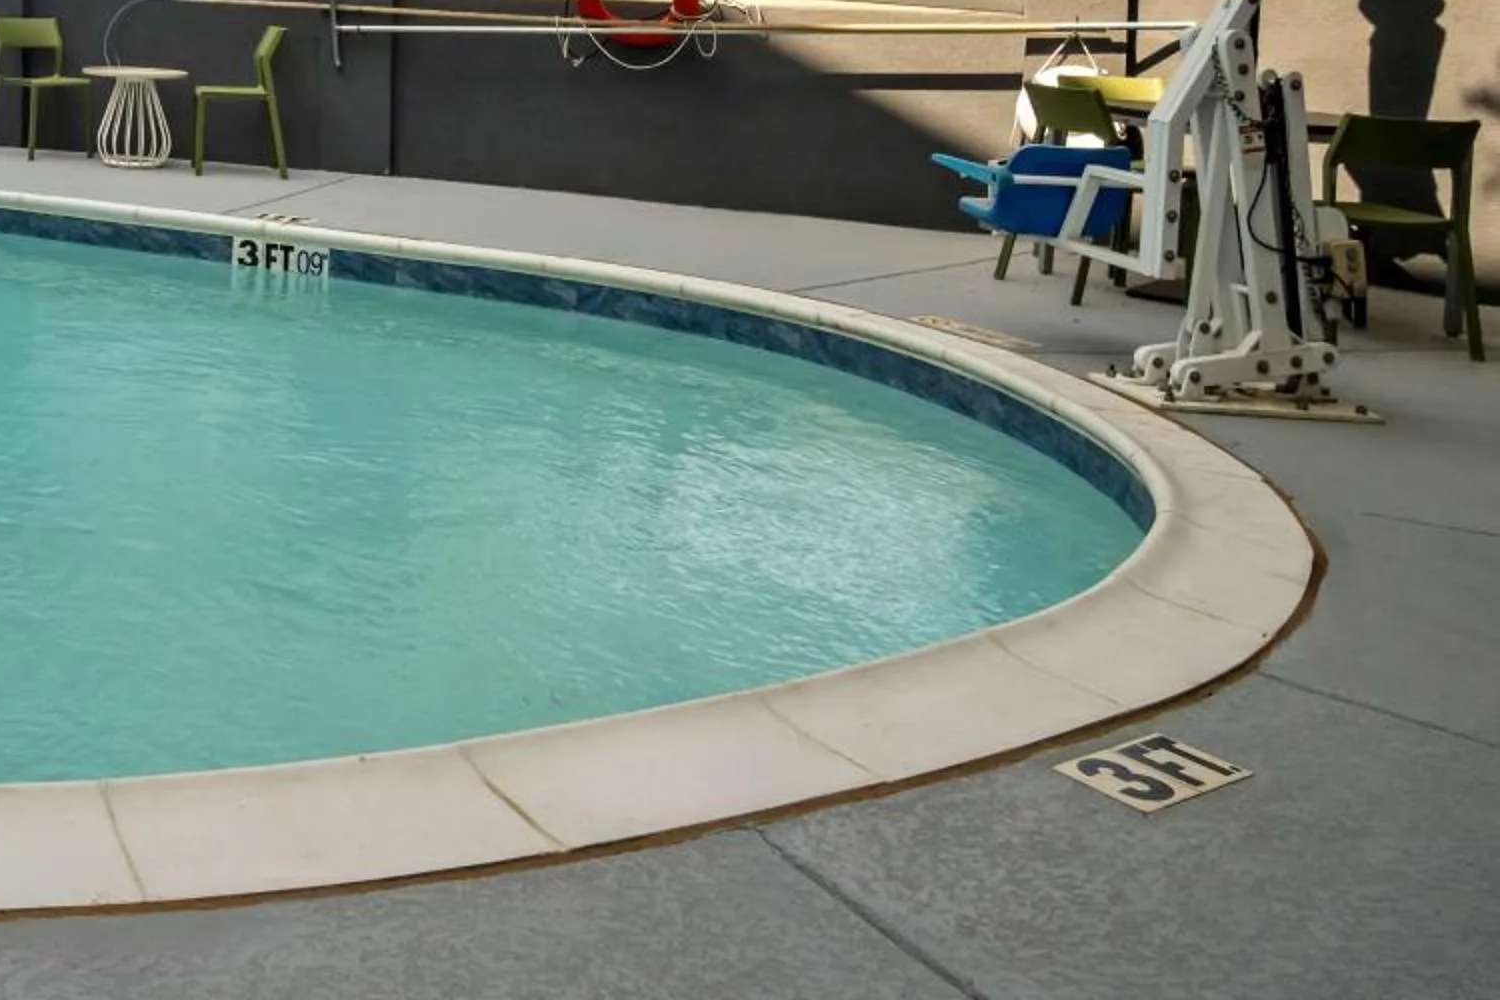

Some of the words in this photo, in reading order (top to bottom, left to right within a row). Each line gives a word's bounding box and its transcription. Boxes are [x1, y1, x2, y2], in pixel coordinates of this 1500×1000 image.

[237, 239, 260, 267] 3
[265, 243, 295, 272] FT
[1076, 758, 1176, 801] 3
